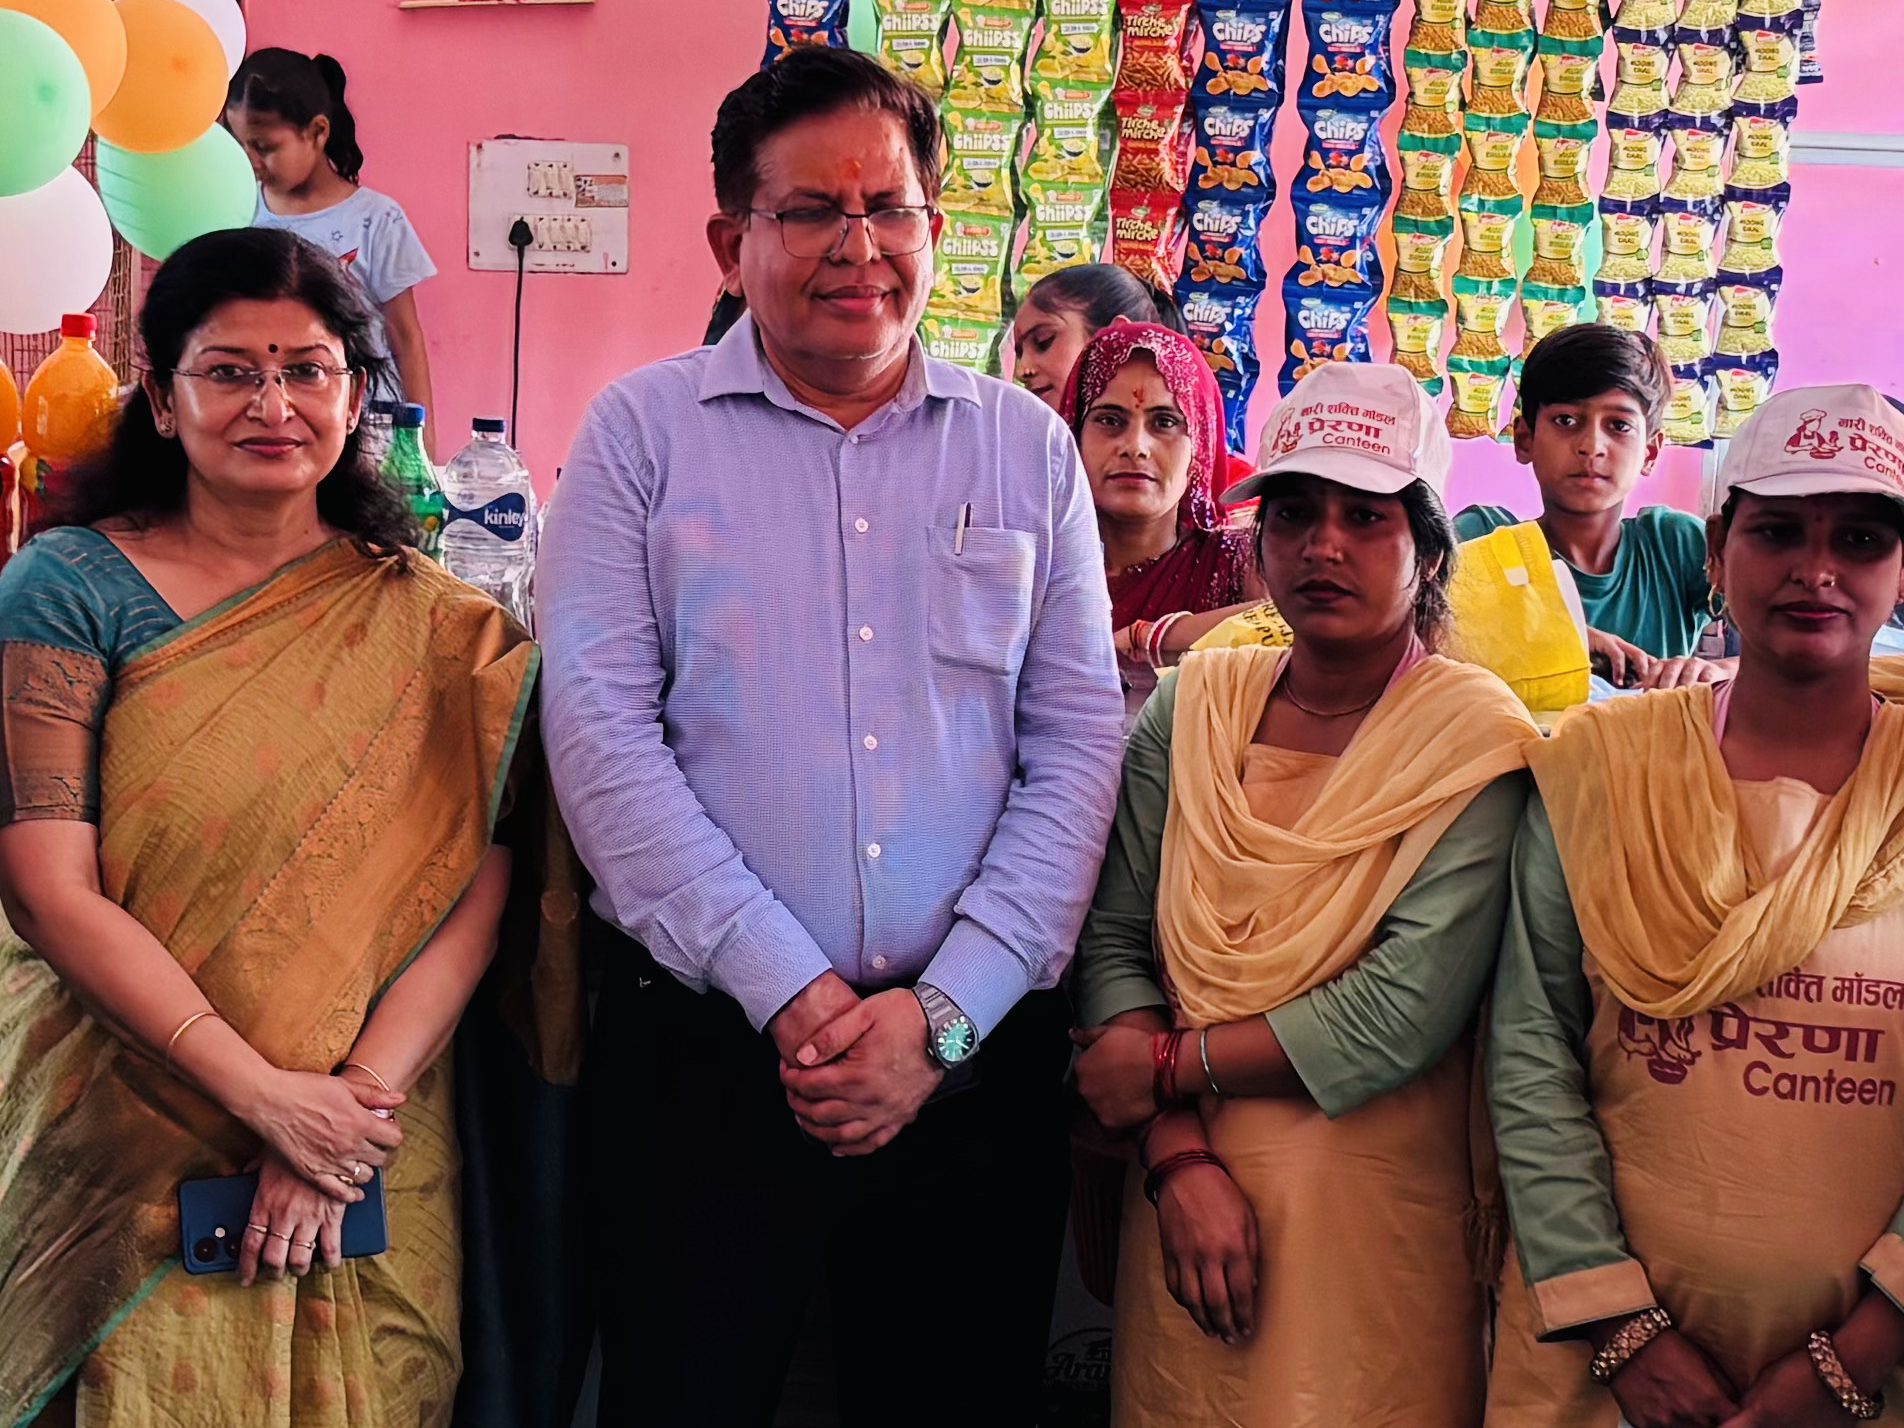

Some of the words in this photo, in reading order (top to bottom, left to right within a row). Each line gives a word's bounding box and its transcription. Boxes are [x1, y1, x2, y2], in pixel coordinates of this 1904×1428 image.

[1307, 417, 1383, 439] प्रेरणा
[1322, 433, 1391, 455] Canteen
[1707, 1003, 1885, 1063] प्रेरणा
[1743, 1061, 1896, 1106] Canteen
